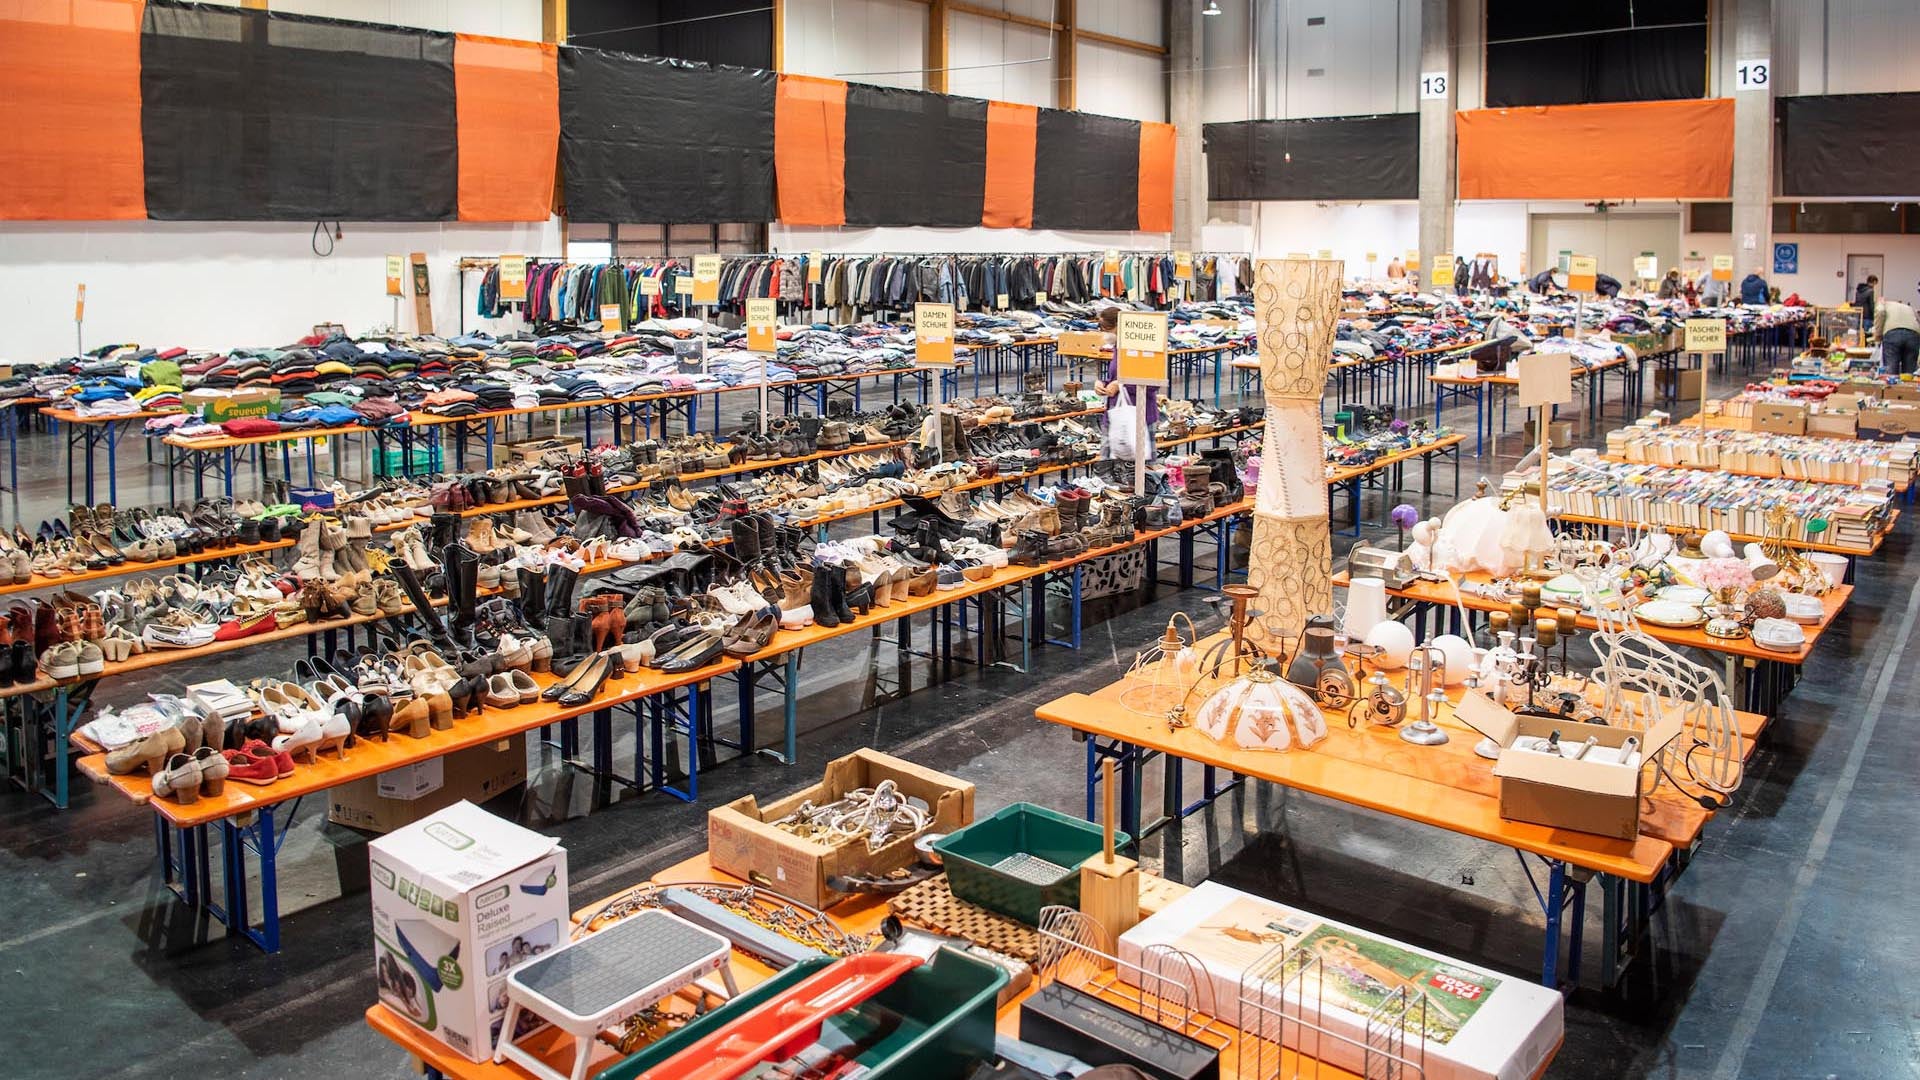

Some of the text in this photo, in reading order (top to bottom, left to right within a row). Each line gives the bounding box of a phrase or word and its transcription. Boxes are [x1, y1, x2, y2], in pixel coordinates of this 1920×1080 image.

[1738, 65, 1767, 84] 13
[1423, 77, 1446, 94] 13
[923, 311, 947, 319] DAMEN
[922, 320, 948, 329] SCHUHE
[1125, 320, 1157, 330] KINDER-
[1124, 332, 1157, 342] SCHUHE
[228, 405, 268, 417] Bananas
[477, 903, 510, 923] Deluxe
[478, 913, 511, 933] Raised
[443, 960, 457, 974] 3X
[1440, 983, 1474, 999] PLU
